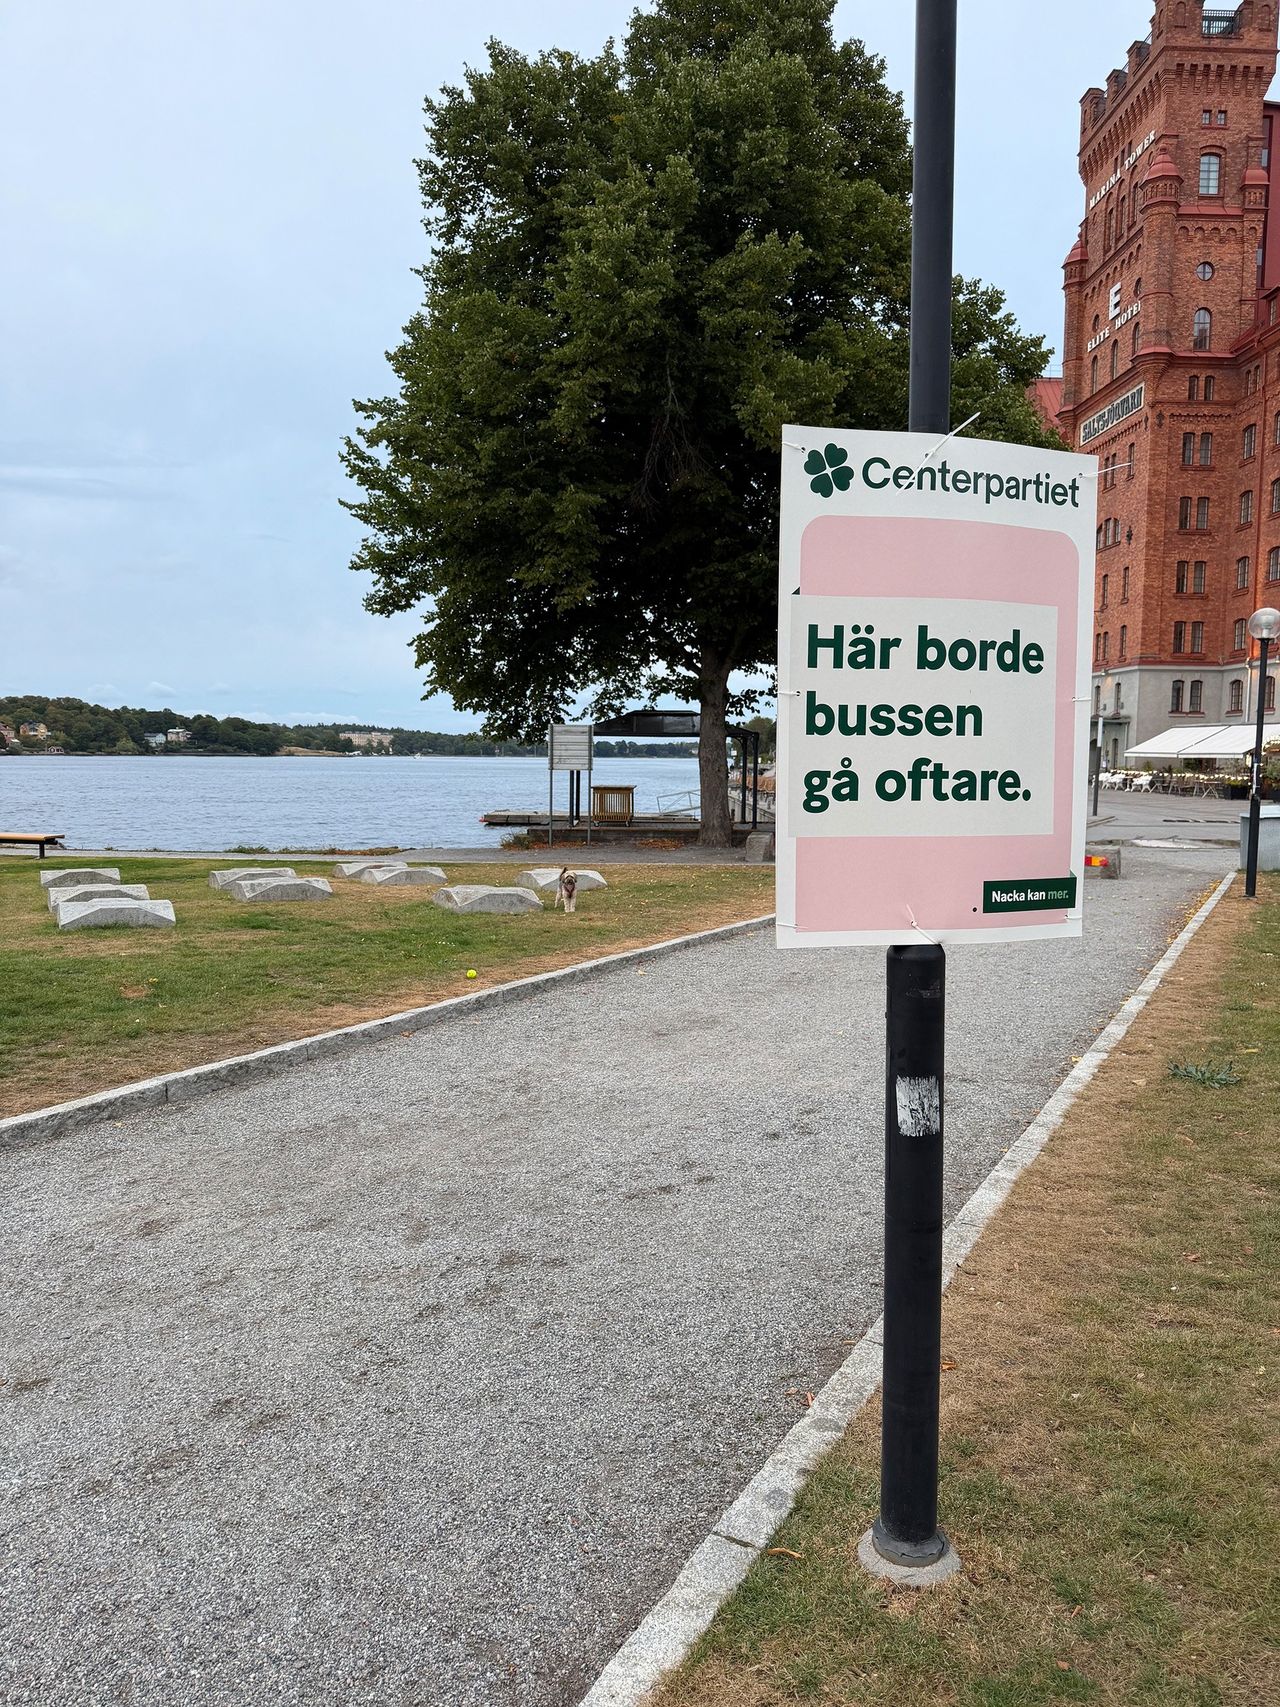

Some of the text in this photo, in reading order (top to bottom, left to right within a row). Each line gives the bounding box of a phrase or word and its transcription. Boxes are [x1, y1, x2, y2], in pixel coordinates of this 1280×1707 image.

[1089, 130, 1156, 210] MARINA TOWER
[1109, 282, 1122, 320] E
[1087, 326, 1110, 353] ELITE
[862, 456, 1080, 508] Centerpartiet
[806, 623, 1044, 674] Här borde
[805, 690, 983, 737] bussen
[802, 757, 1031, 813] gå oftare.
[991, 889, 1069, 903] Nacka kan mer.
